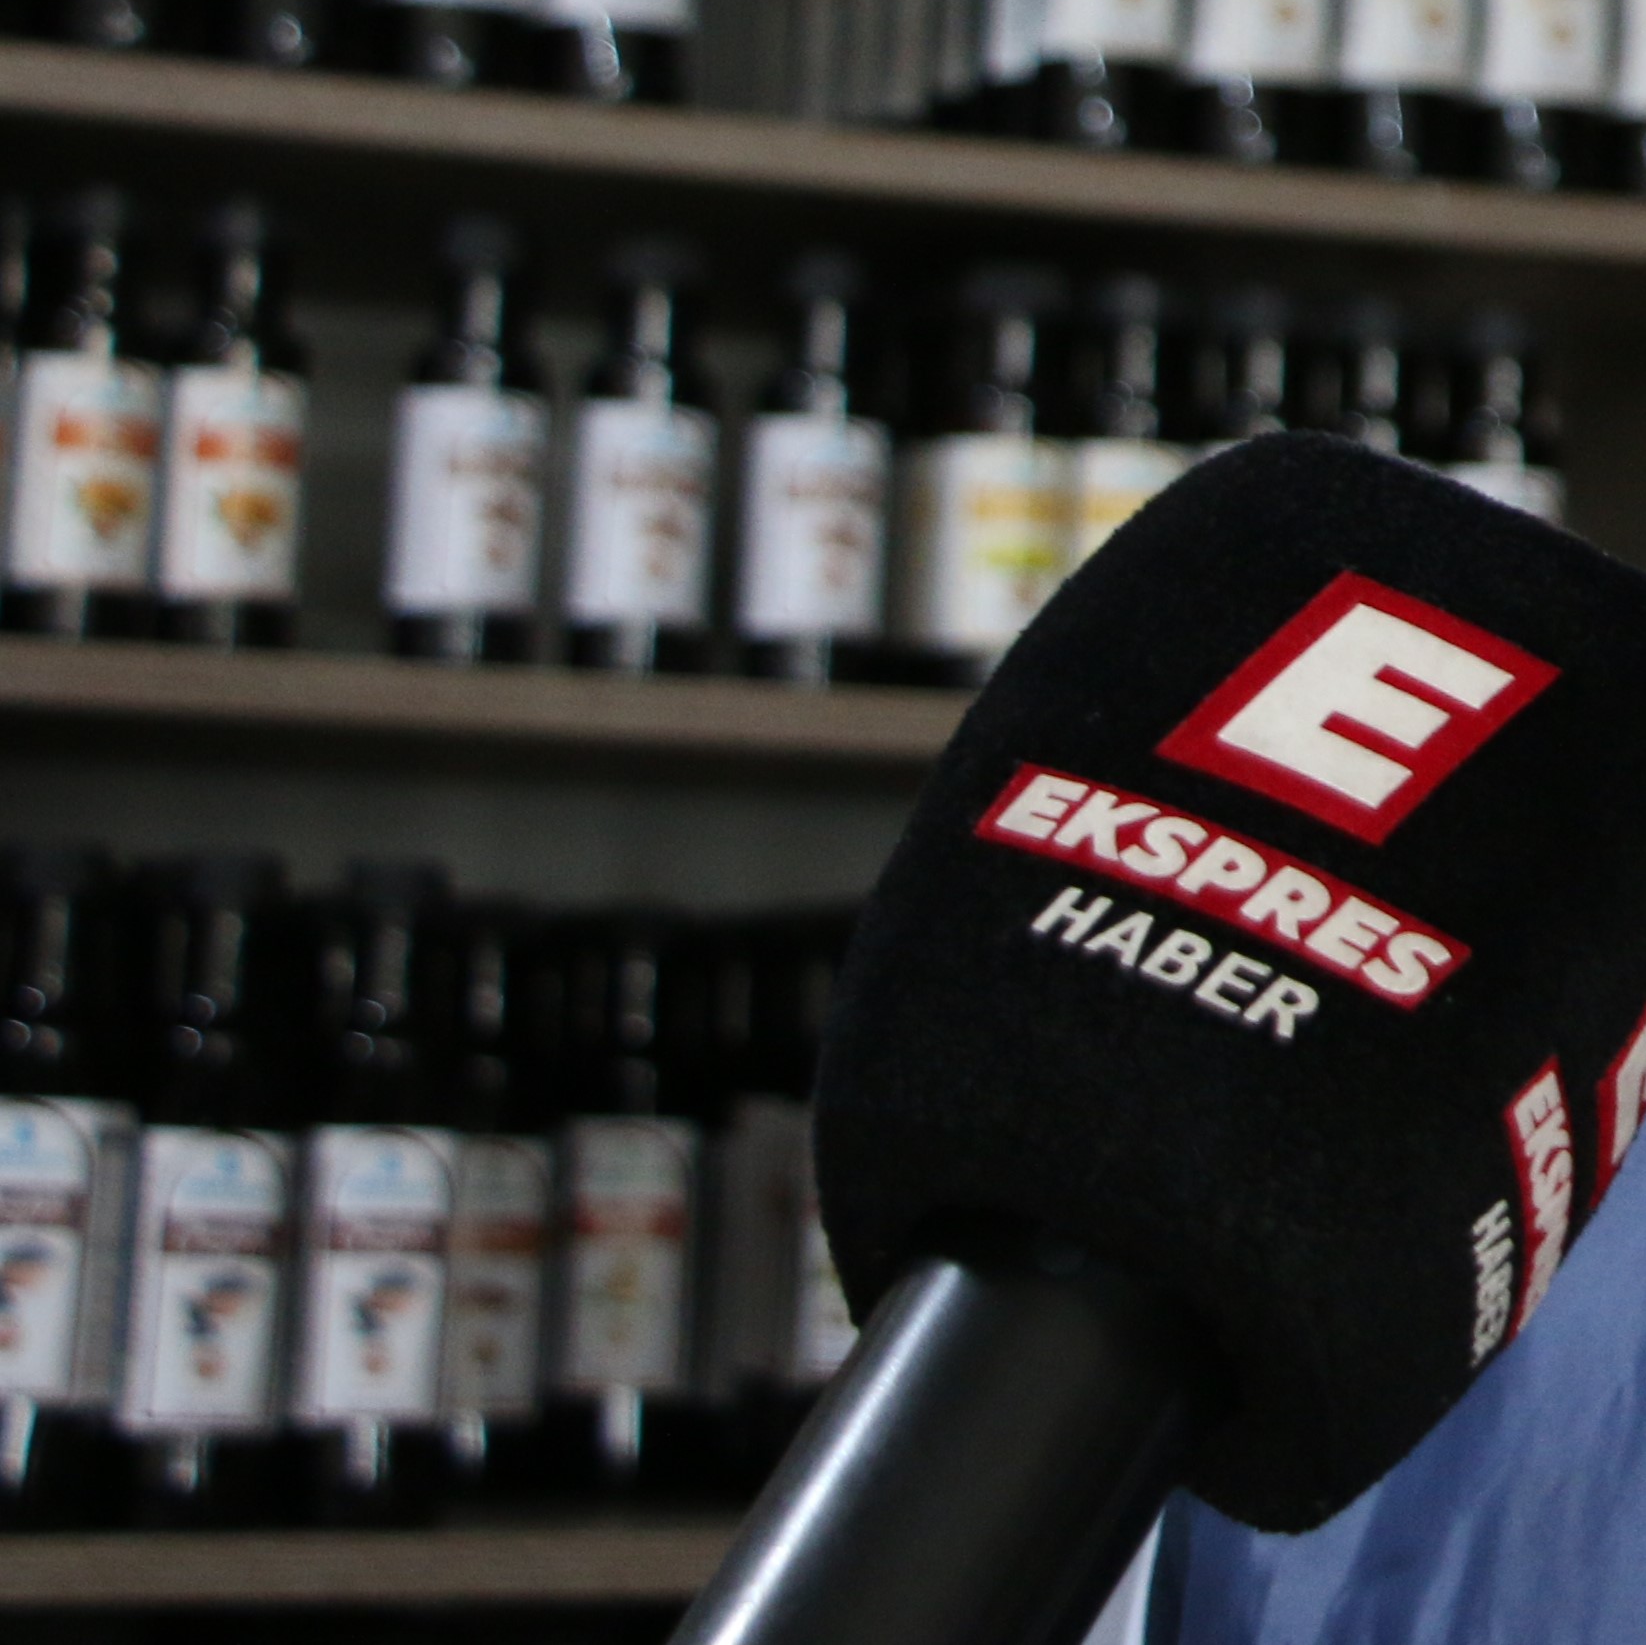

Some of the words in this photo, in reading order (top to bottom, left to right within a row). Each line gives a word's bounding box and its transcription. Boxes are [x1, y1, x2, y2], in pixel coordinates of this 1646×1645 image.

[1215, 601, 1516, 813] E
[994, 777, 1451, 1000] EKSPRES
[1031, 885, 1321, 1043] HABER
